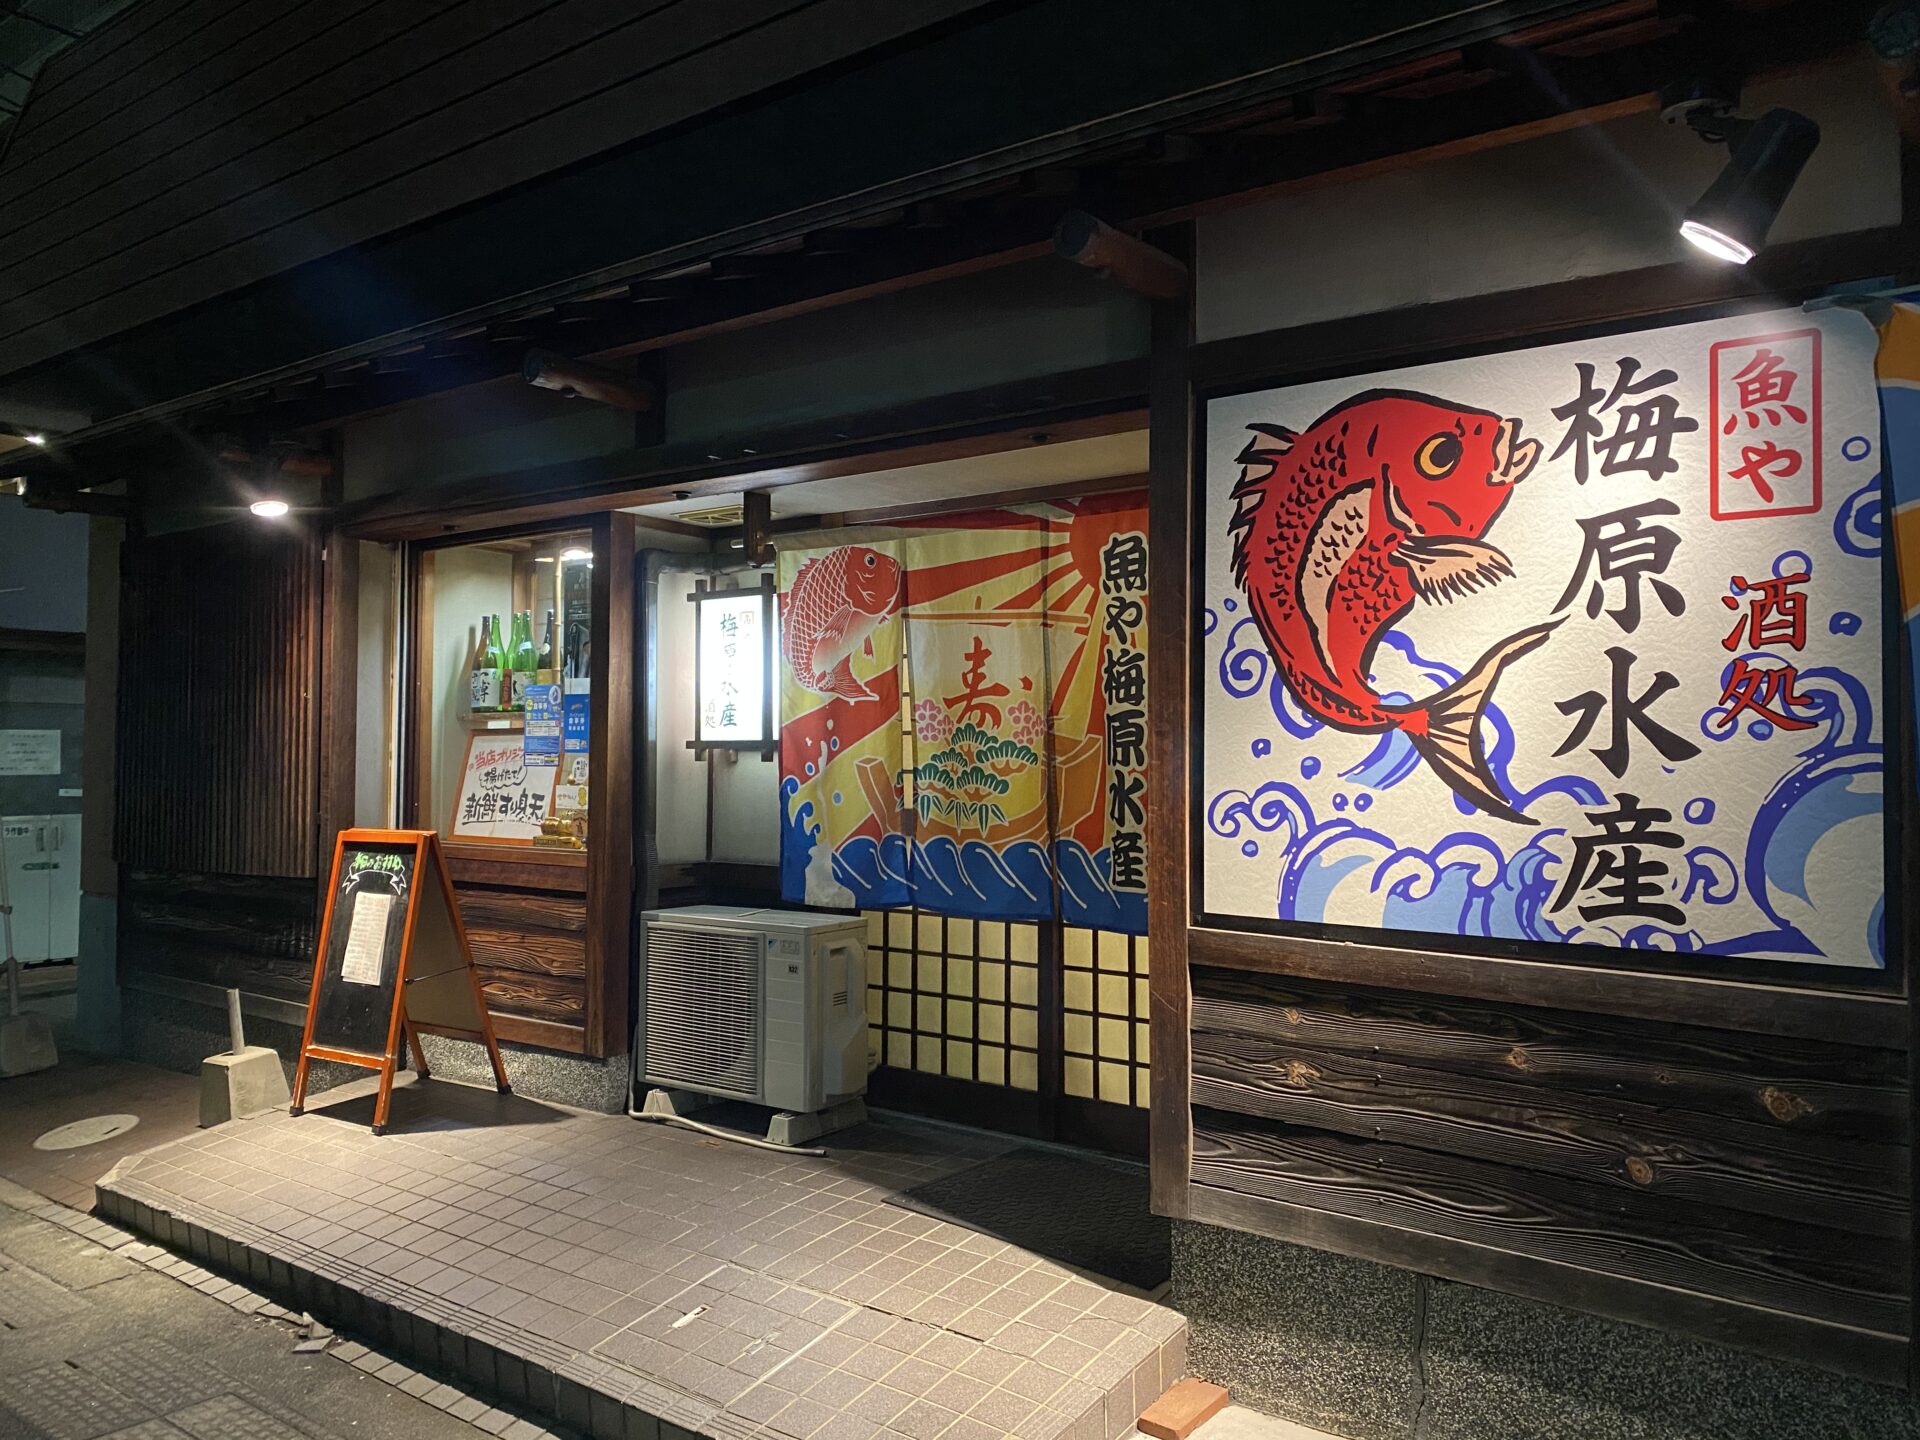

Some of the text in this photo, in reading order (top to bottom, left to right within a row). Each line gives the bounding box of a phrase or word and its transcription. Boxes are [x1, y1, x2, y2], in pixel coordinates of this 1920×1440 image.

[1723, 349, 1808, 503] 魚や
[1102, 535, 1148, 890] 魚や梅原水産
[1548, 357, 1701, 926] 梅原水産
[1719, 574, 1819, 731] 酒処
